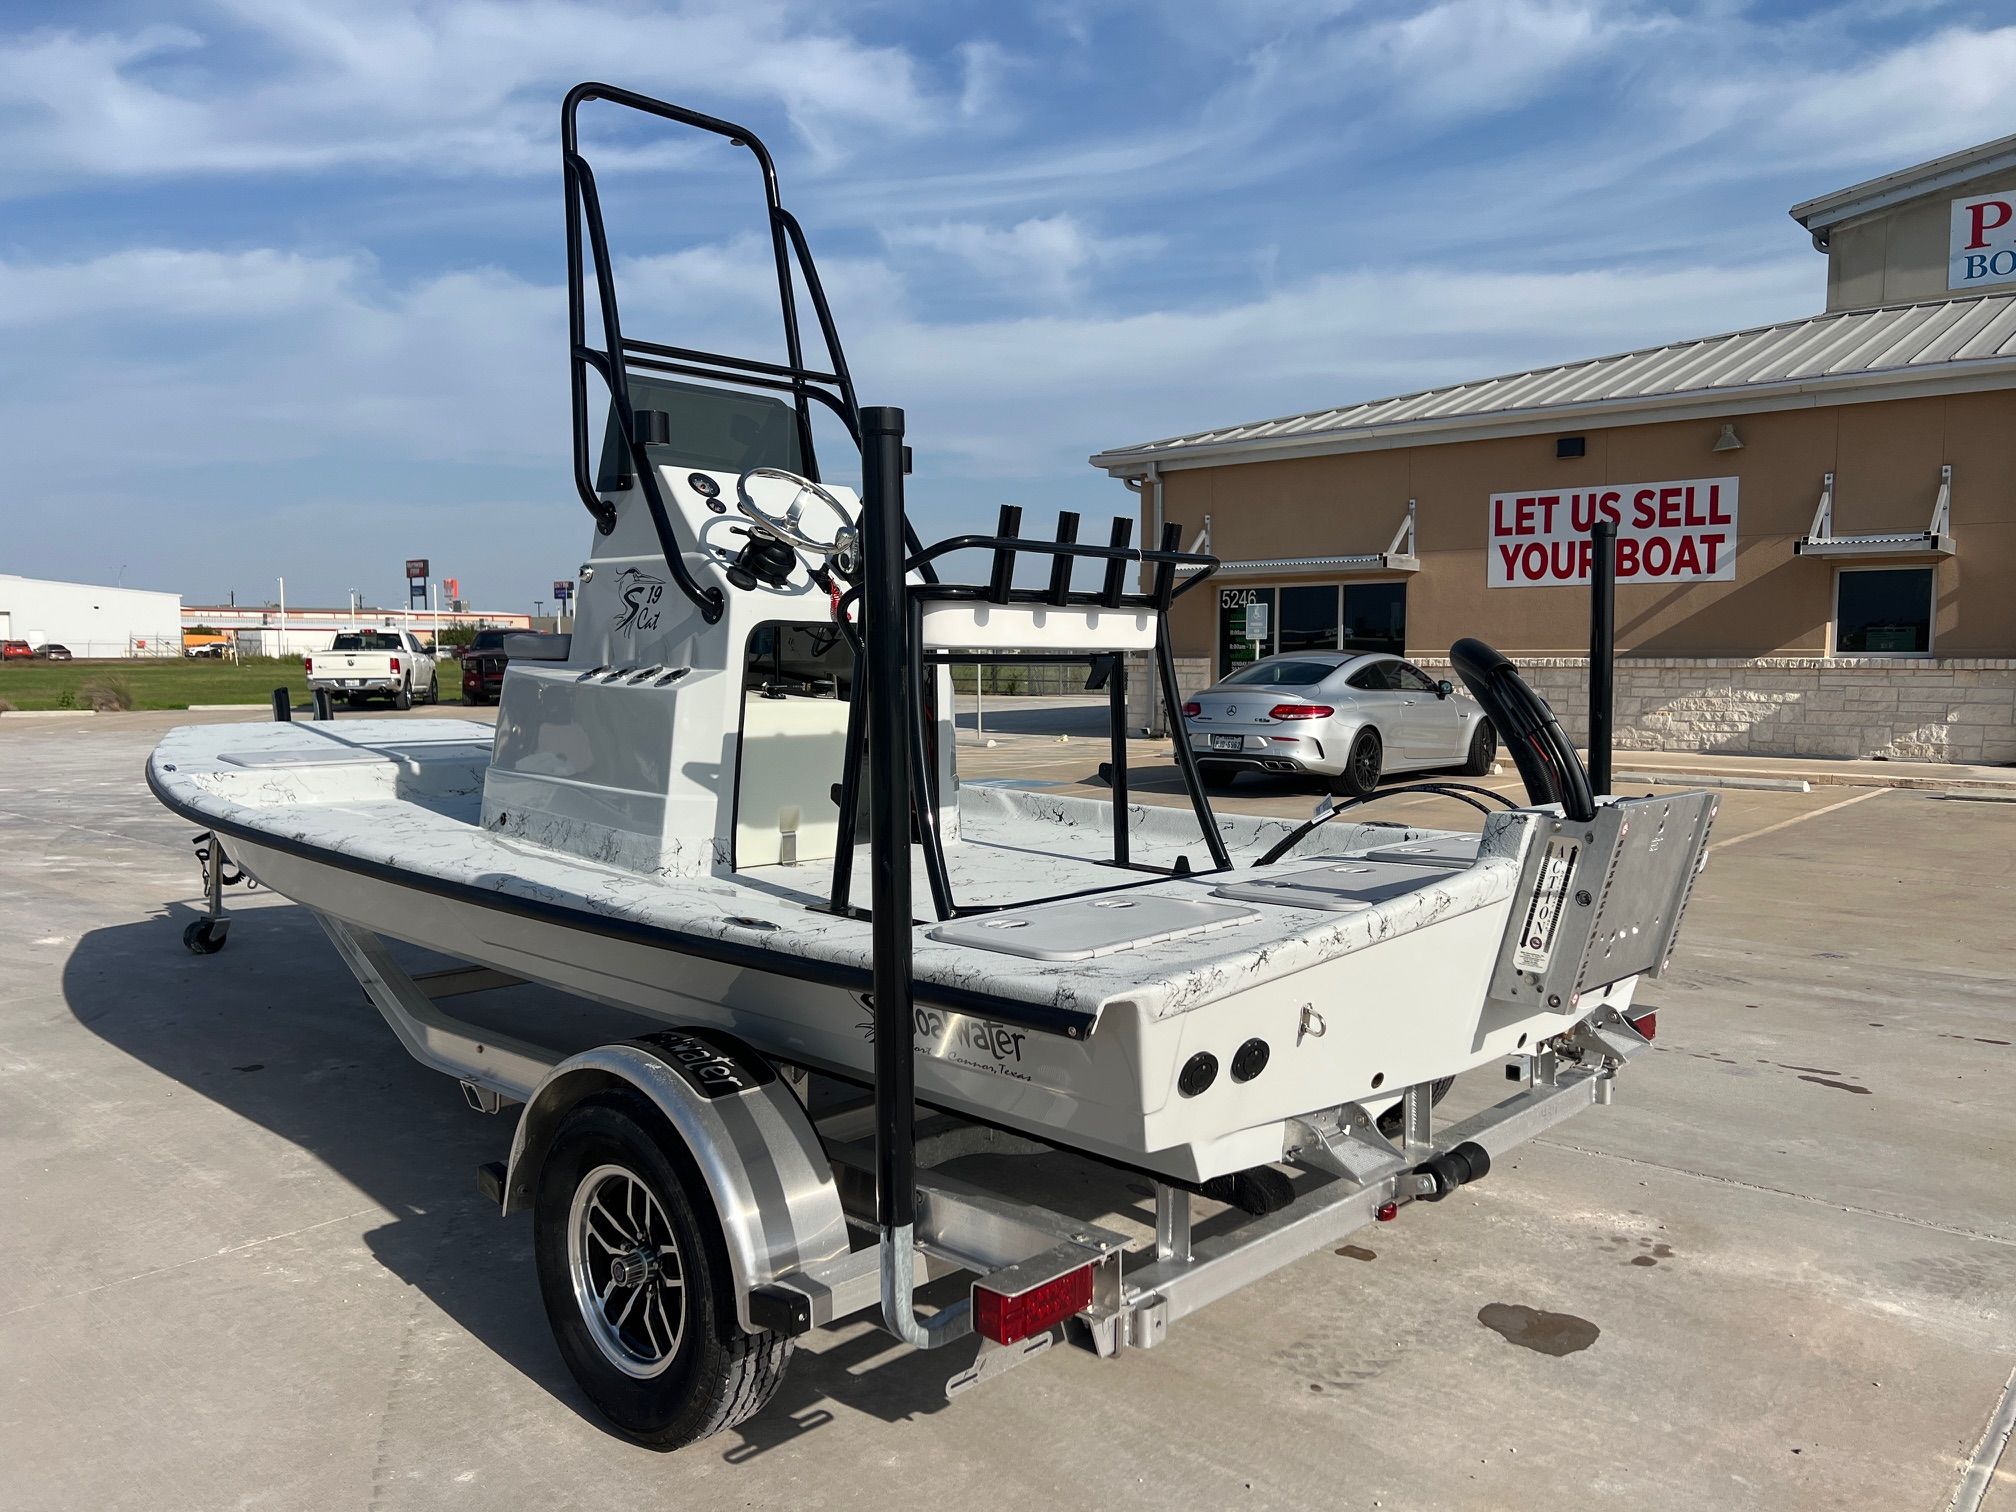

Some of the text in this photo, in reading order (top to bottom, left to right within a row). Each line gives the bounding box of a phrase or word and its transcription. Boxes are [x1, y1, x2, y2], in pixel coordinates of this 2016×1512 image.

[1494, 485, 1731, 537] LET US SELL
[1615, 534, 1725, 577] BOAT
[646, 585, 663, 605] 19
[1222, 590, 1256, 609] 5246
[637, 607, 661, 631] Cat
